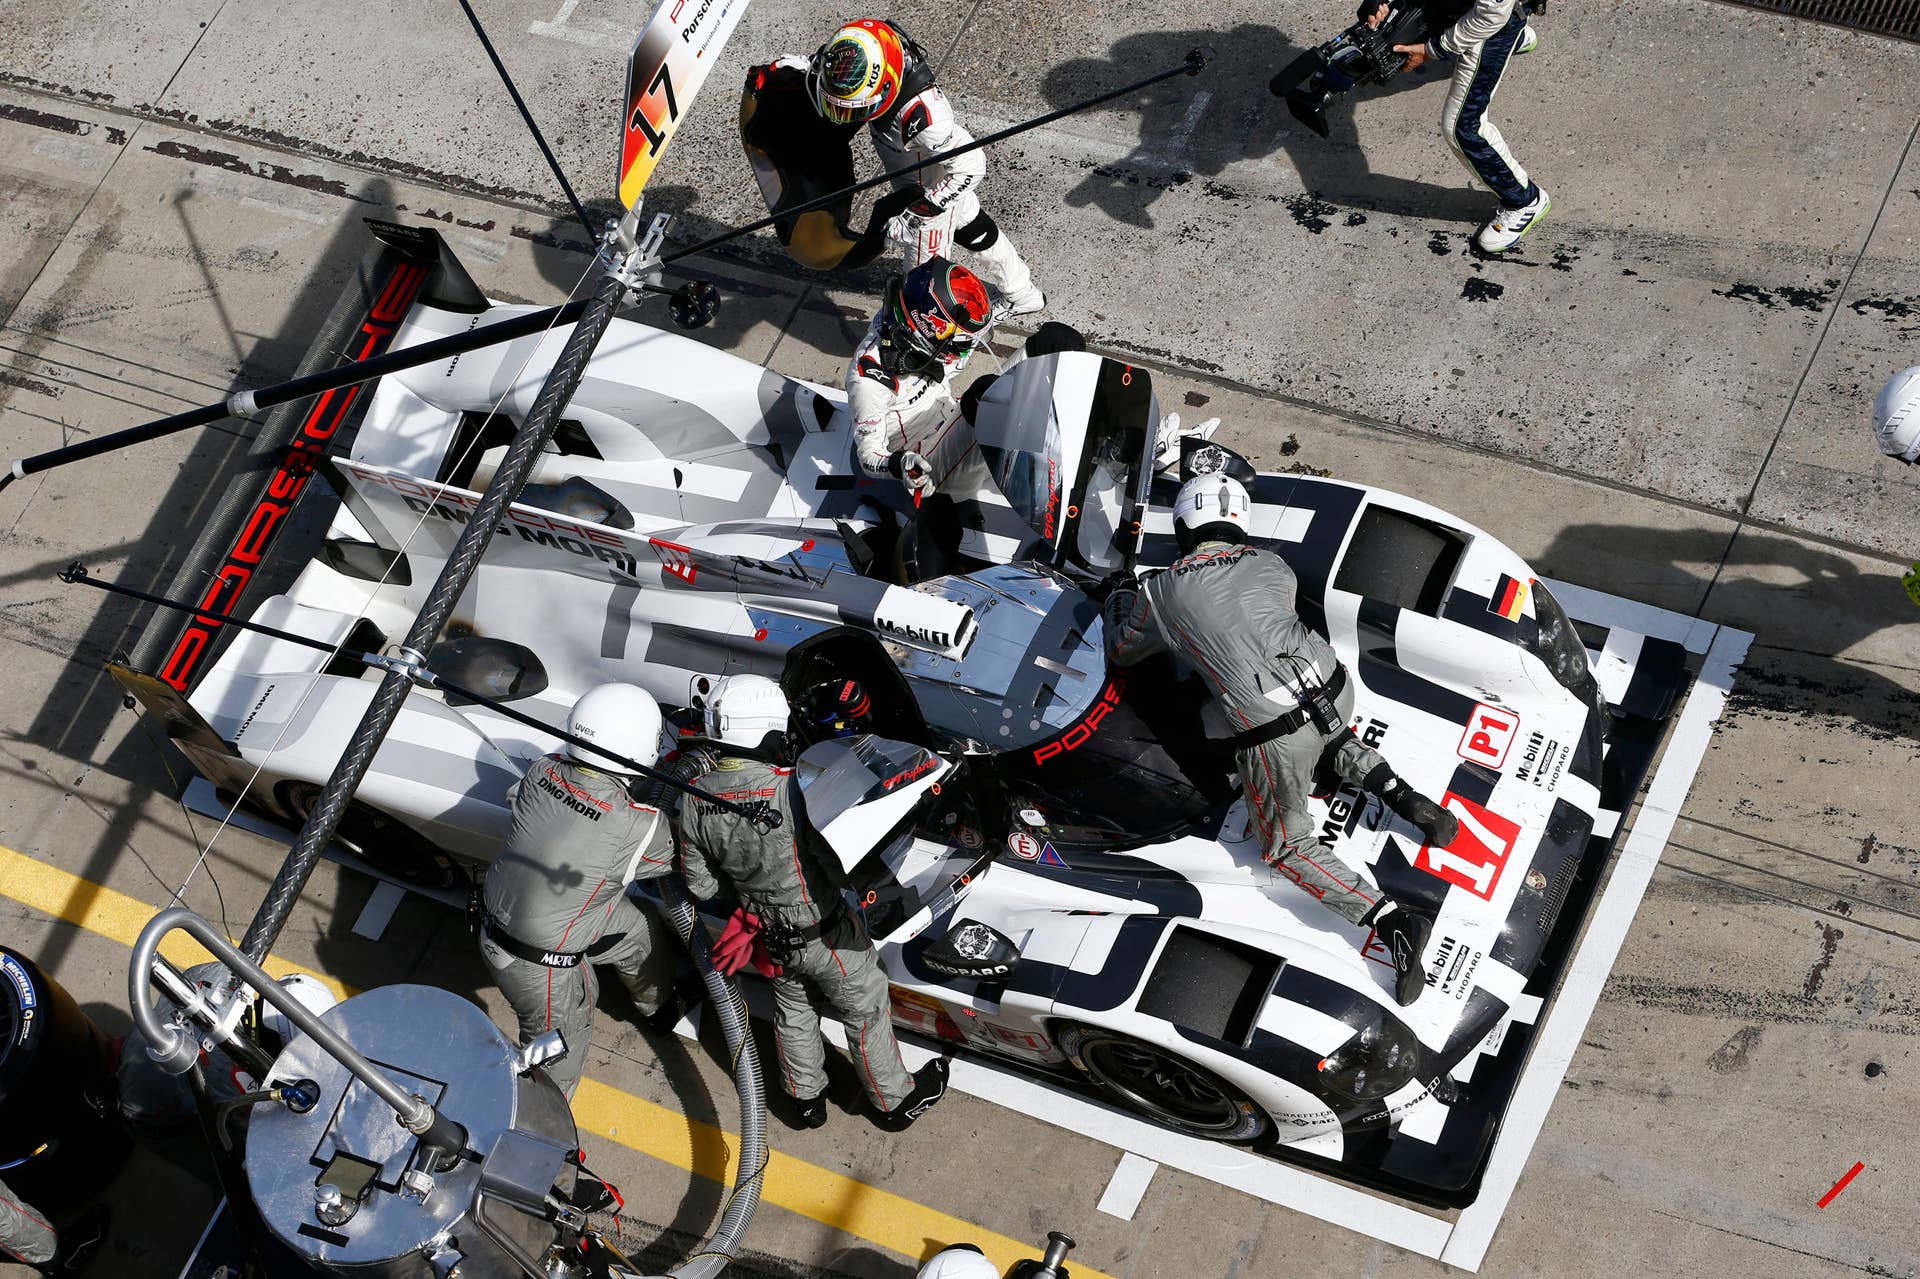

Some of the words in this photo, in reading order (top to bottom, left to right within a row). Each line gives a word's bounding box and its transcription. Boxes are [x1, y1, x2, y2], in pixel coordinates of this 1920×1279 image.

[630, 62, 679, 158] 17
[446, 354, 460, 376] ORI
[160, 262, 428, 692] PORSCHE
[513, 524, 637, 578] MORI
[877, 618, 931, 642] Mobil
[255, 684, 275, 710] DMG
[234, 711, 257, 740] MORI
[574, 722, 596, 737] uvex
[1033, 676, 1128, 766] PORS
[1468, 714, 1511, 758] P1
[1515, 744, 1540, 781] Mobil
[1547, 746, 1570, 792] CHOPARD
[537, 777, 565, 800] DMG
[562, 795, 602, 822] MORI
[1318, 799, 1351, 850] MG
[1427, 797, 1508, 895] 17
[540, 952, 577, 967] MRTC
[925, 960, 1009, 977] CHOPARD
[1424, 949, 1450, 988] Mobil
[1456, 951, 1482, 1000] CHOPARD
[6, 961, 33, 1005] MICHELIN
[1403, 1076, 1441, 1109] MORI
[1311, 1118, 1336, 1126] FAG
